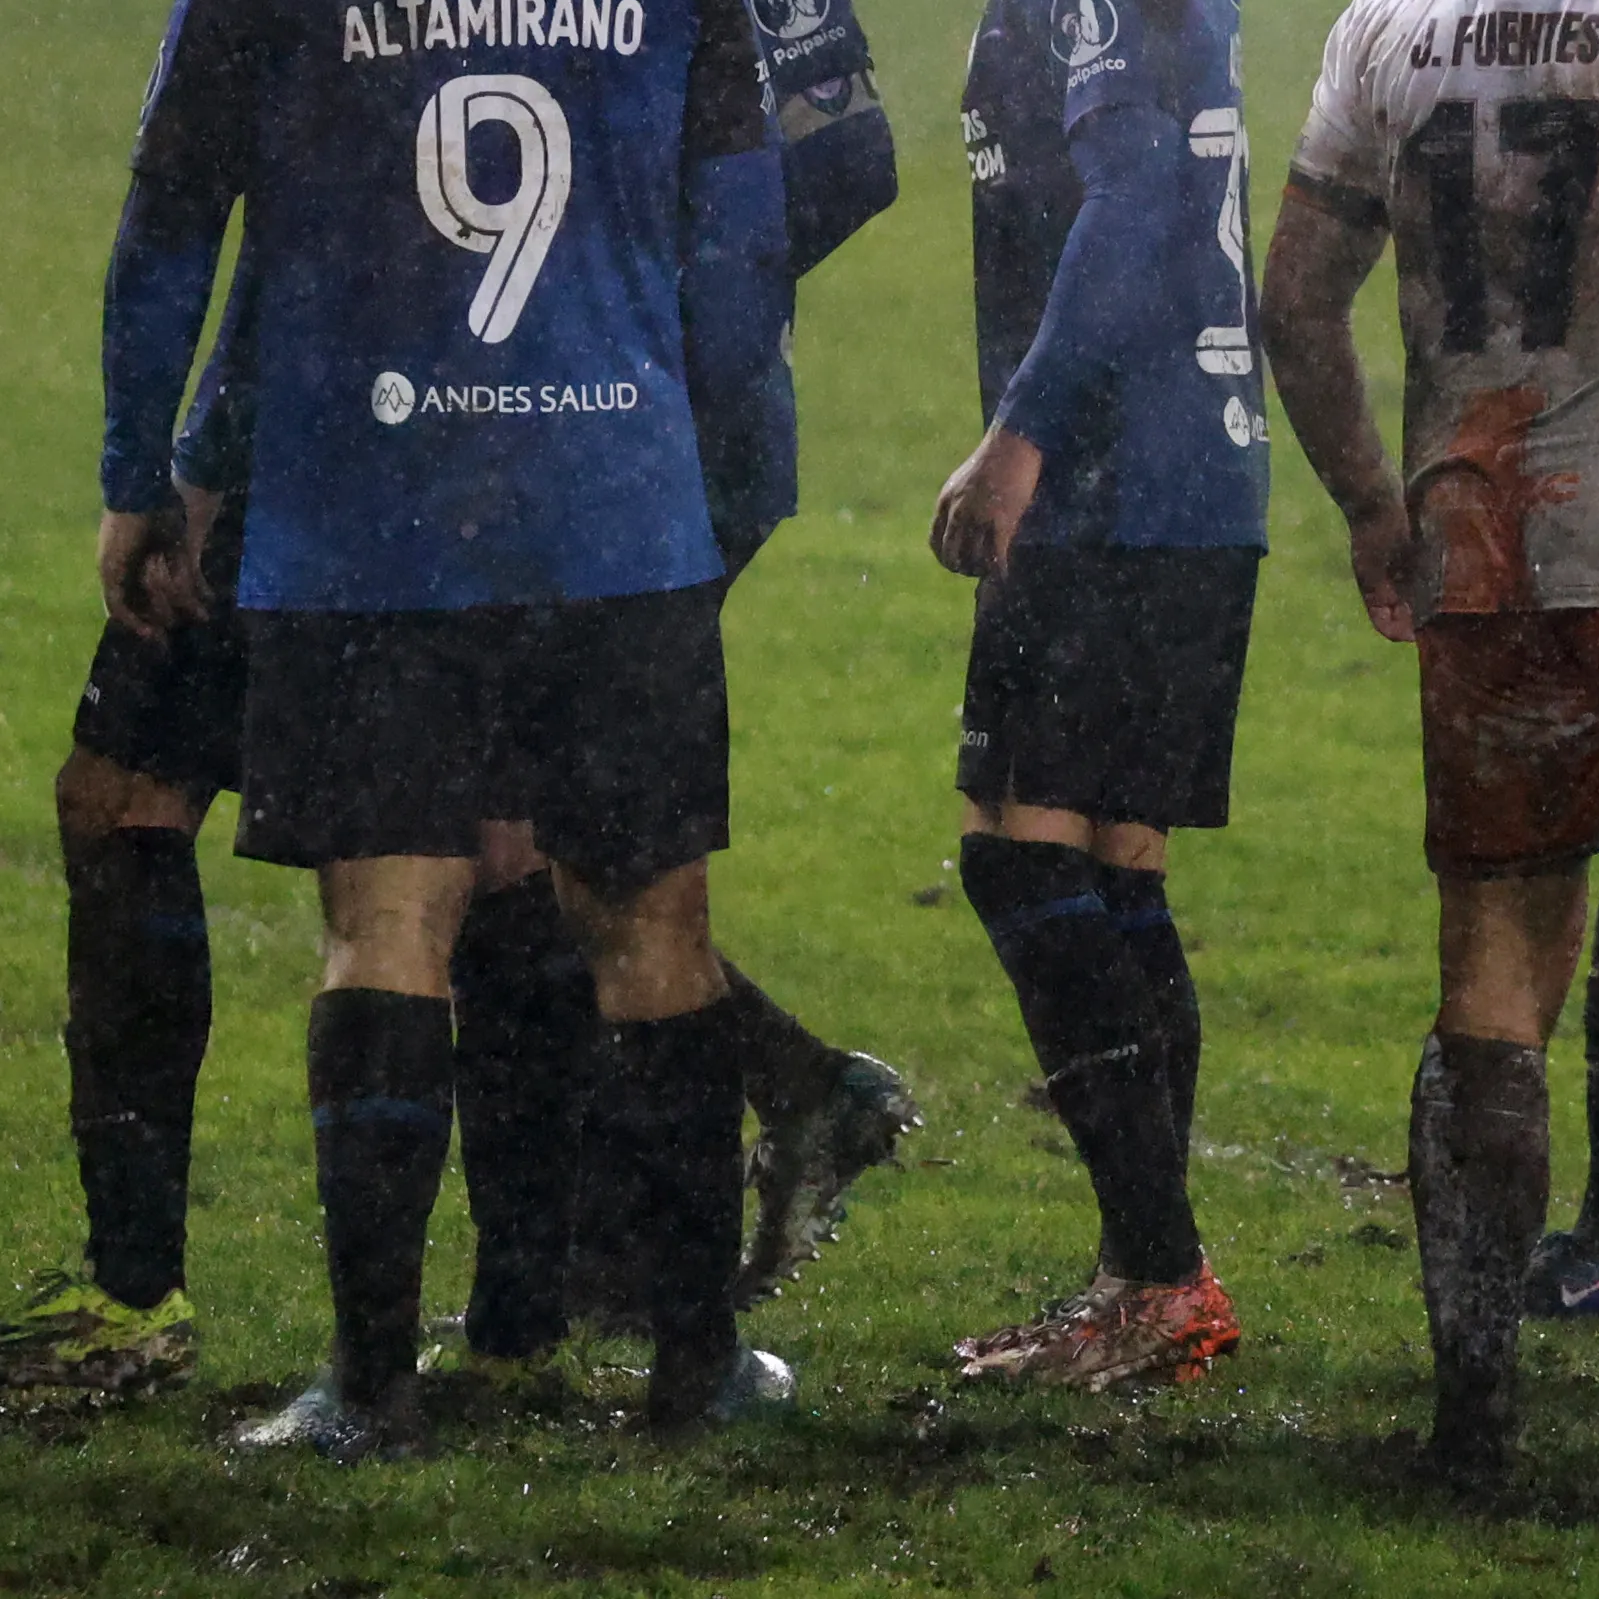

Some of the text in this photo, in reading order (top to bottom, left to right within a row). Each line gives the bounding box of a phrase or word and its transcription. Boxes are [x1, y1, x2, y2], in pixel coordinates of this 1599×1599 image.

[772, 25, 847, 66] Polpaico
[1410, 18, 1442, 70] J.
[415, 73, 572, 343] 9
[420, 381, 639, 414] ANDES SALUD
